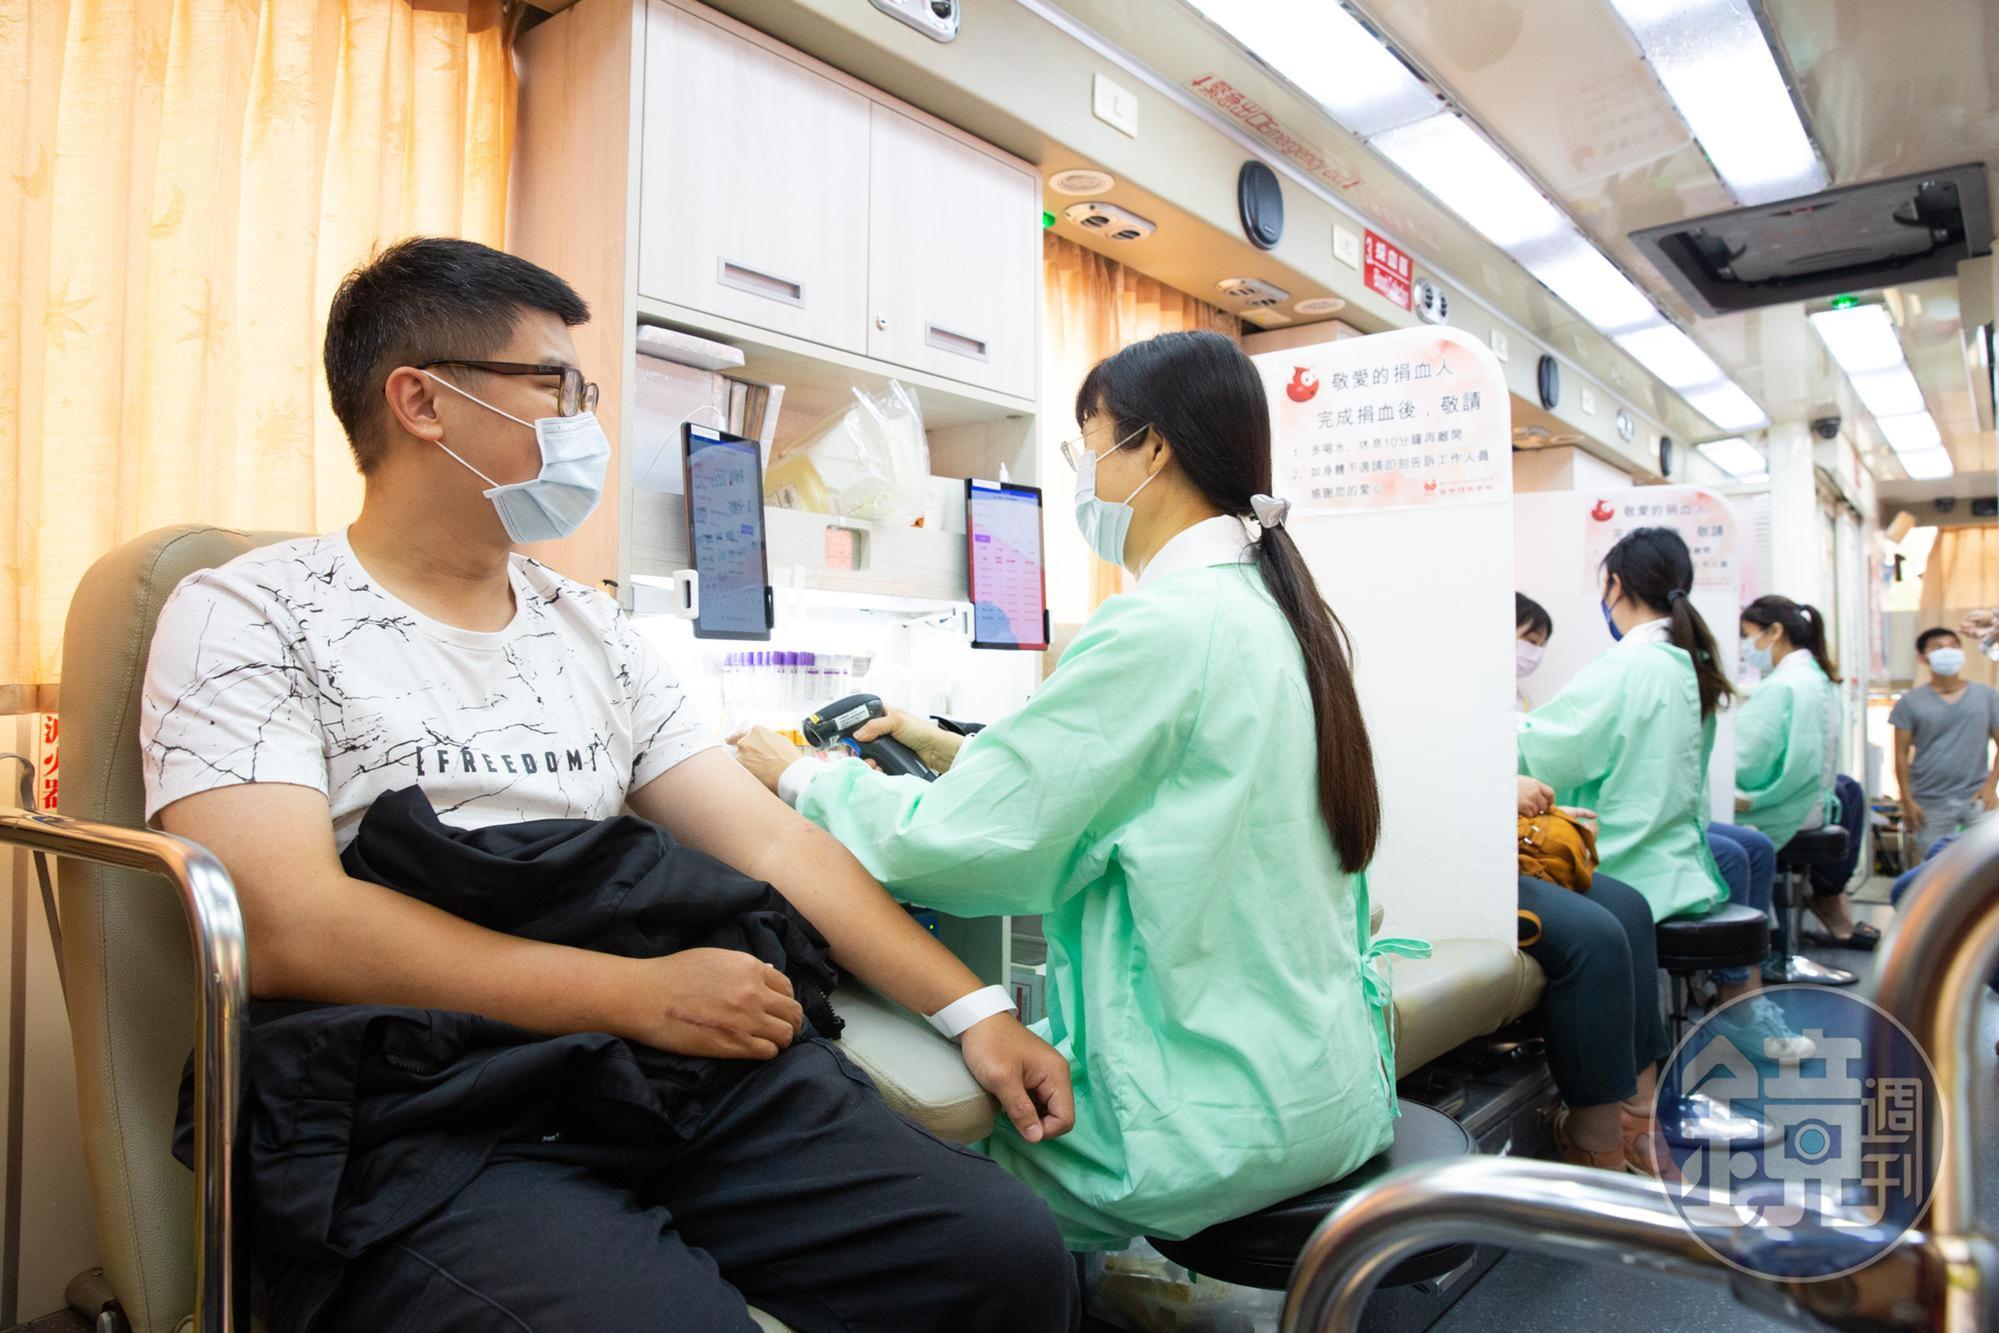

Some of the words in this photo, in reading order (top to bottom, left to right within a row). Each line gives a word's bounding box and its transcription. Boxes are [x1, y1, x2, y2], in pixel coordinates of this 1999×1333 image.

[1331, 358, 1454, 392] 敬愛的捐血人
